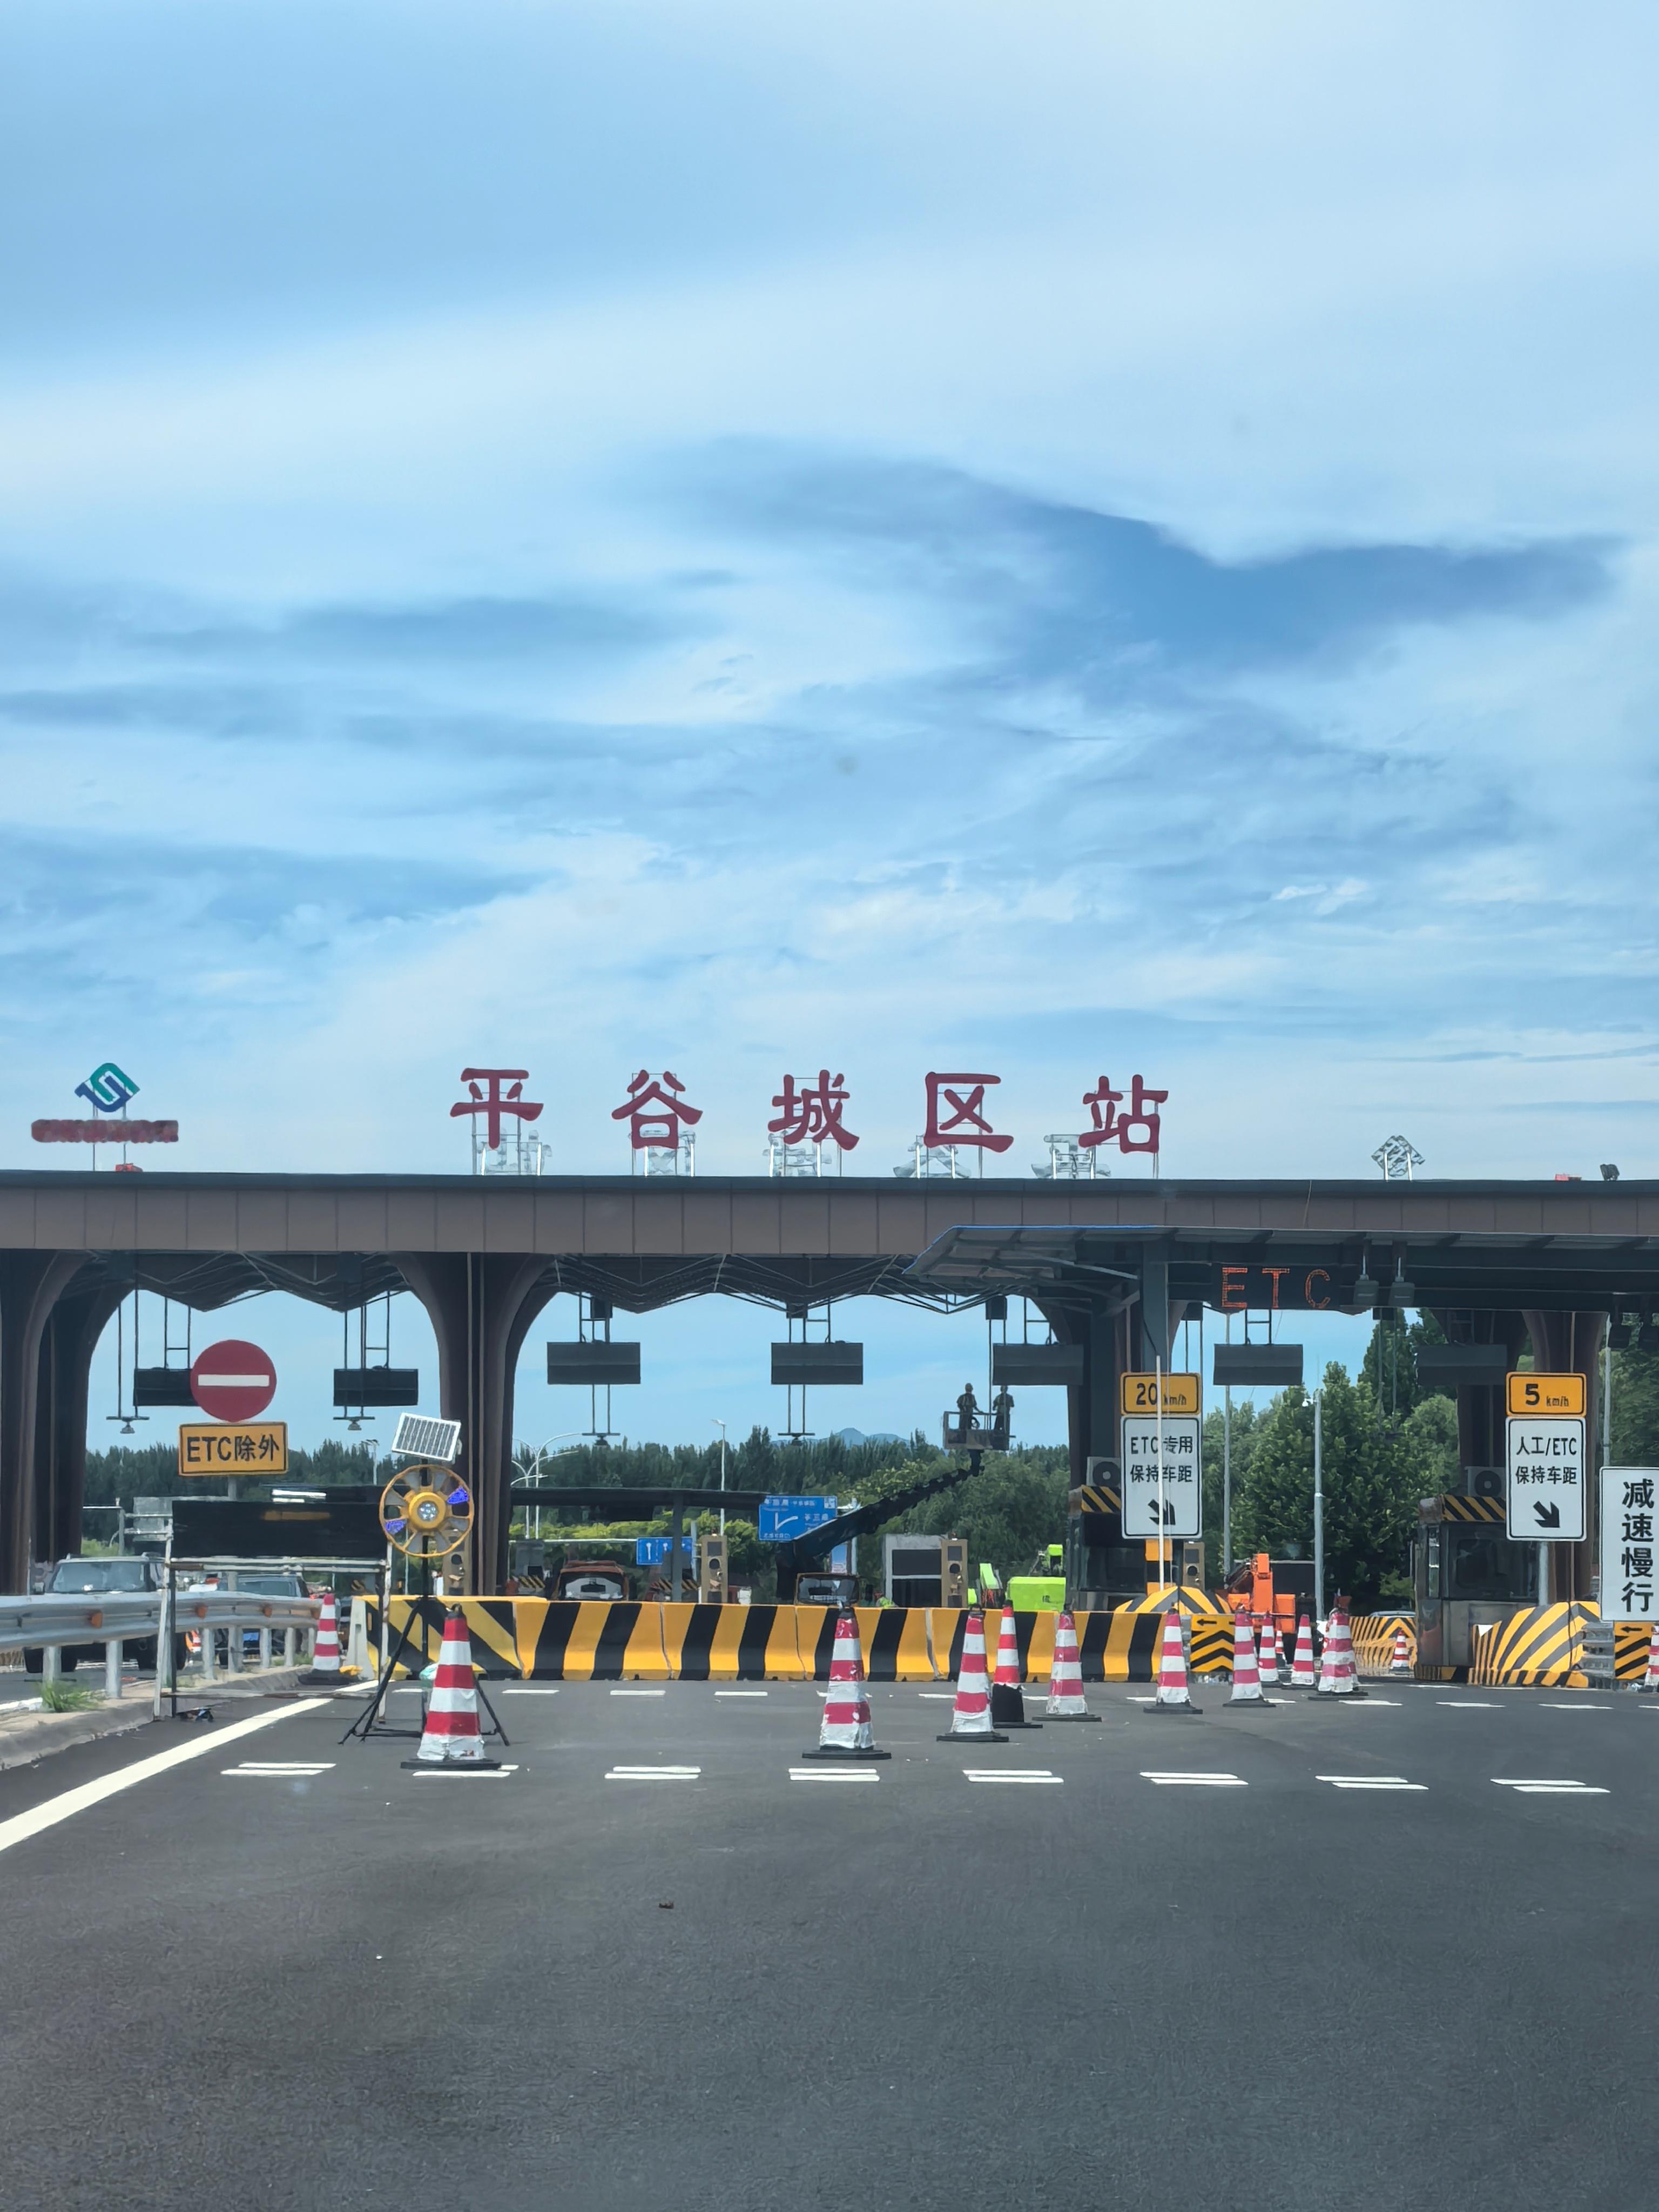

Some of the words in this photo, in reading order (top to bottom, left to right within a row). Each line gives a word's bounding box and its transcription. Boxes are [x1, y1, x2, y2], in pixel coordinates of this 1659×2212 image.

[450, 1068, 1168, 1154] 平谷城区站
[1222, 1267, 1331, 1309] ETC
[1136, 1382, 1157, 1405] 20
[1525, 1383, 1540, 1405] 5
[1546, 1395, 1569, 1407] km/h
[187, 1433, 279, 1462] ETC除外
[1516, 1436, 1577, 1456] 人工/ETC
[1130, 1464, 1193, 1483] 保持车距
[1515, 1465, 1577, 1485] 保持车距
[1621, 1478, 1655, 1613] 减速慢行
